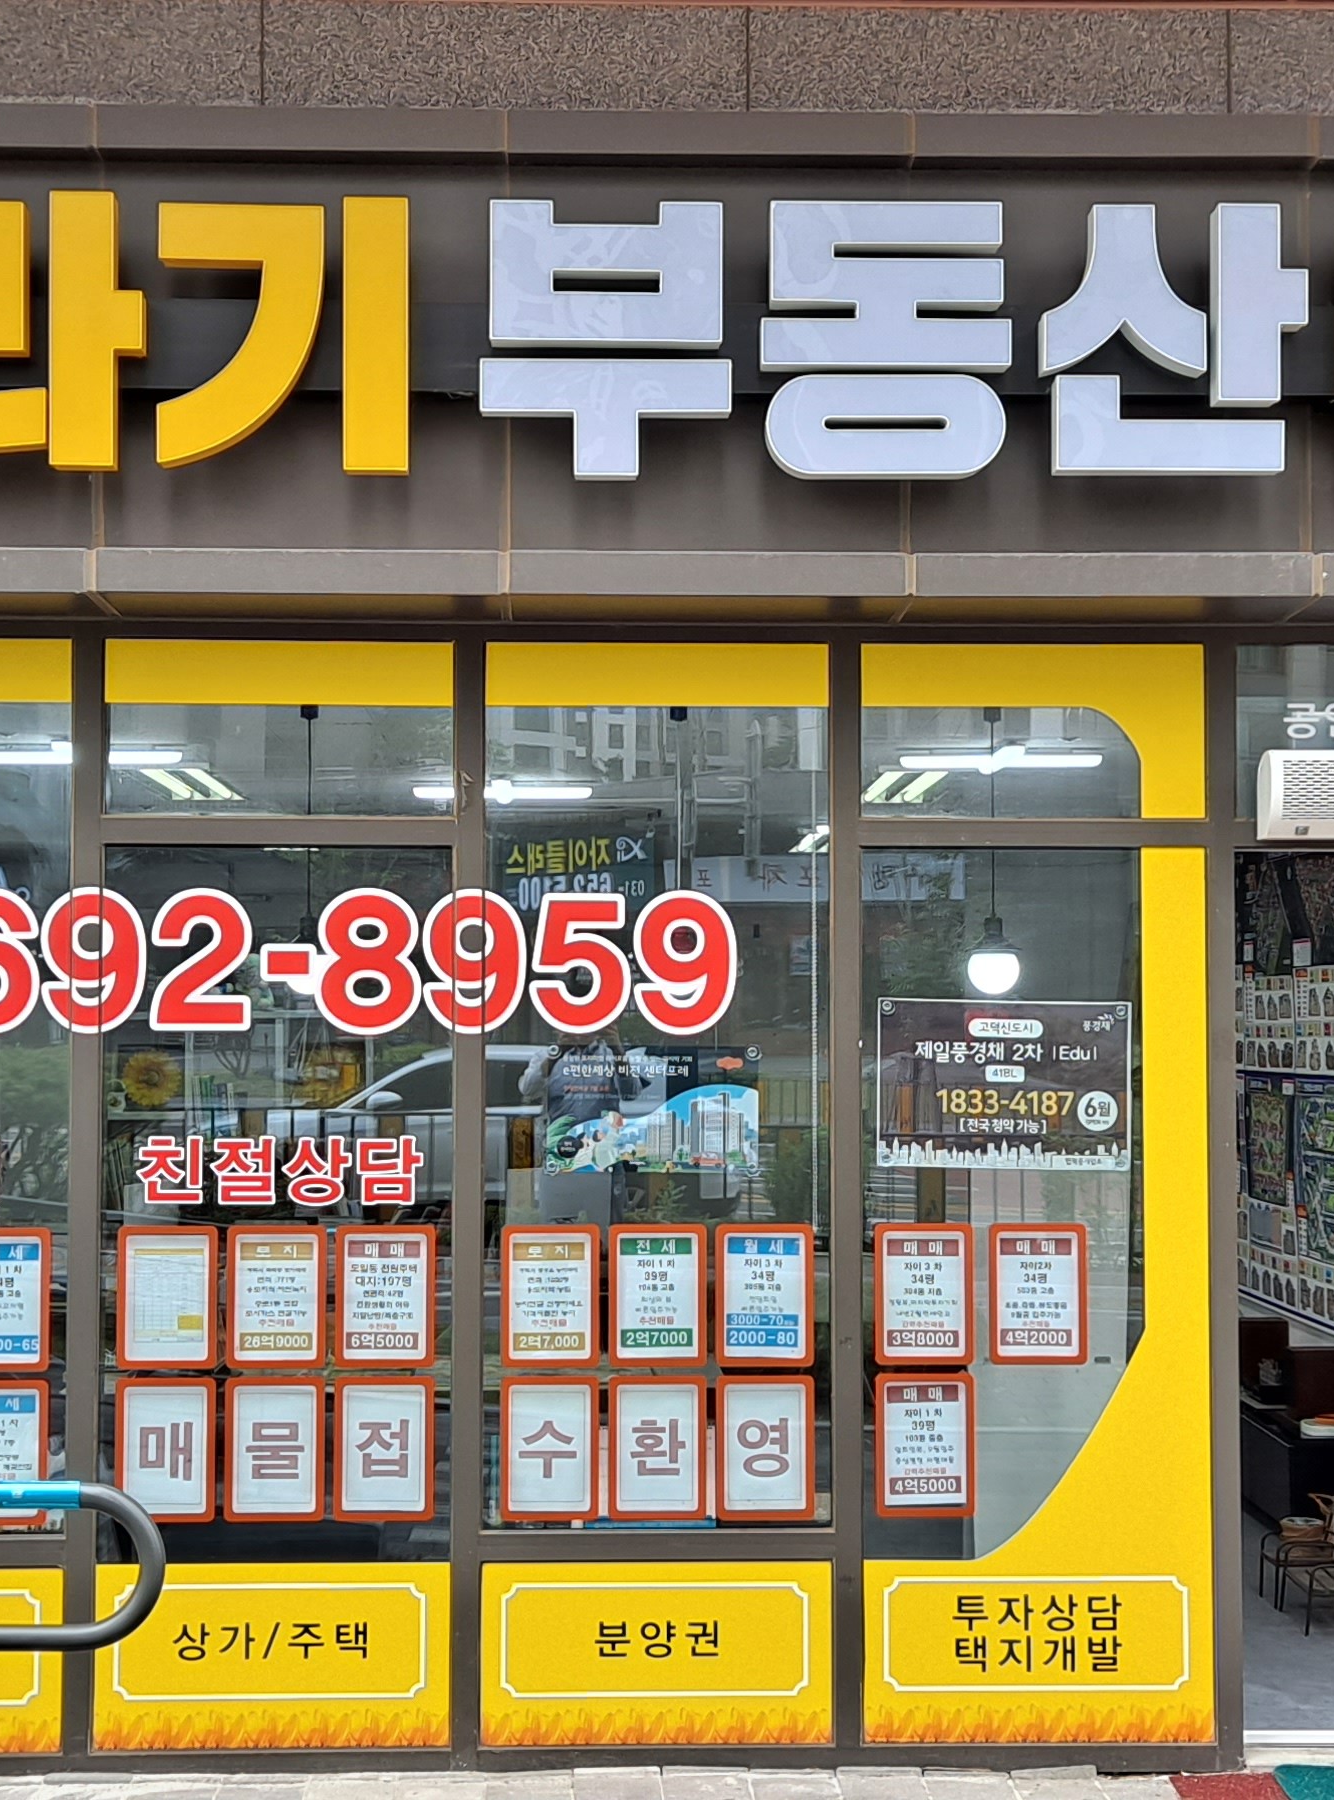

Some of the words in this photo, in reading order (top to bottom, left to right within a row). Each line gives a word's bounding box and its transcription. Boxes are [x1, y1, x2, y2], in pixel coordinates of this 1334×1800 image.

[478, 200, 1309, 482] 부동산
[979, 1022, 1033, 1035] 고덕신도시
[915, 1041, 1004, 1065] 제일풍경채
[1012, 1042, 1044, 1062] 2차
[563, 1064, 615, 1077] e편한세상
[935, 1088, 1075, 1116] 1833-4187
[1084, 1098, 1111, 1117] 6월
[136, 1134, 425, 1206] 친절상담
[1023, 1273, 1048, 1284] 34평
[731, 1315, 784, 1325] 3000-70
[351, 1334, 414, 1348] 6억5000
[519, 1335, 579, 1349] 2억7,000
[626, 1331, 688, 1346] 2억7000
[729, 1331, 795, 1345] 2000-80
[1006, 1330, 1067, 1345] 4억2000
[895, 1478, 957, 1493] 4억5000
[952, 1594, 1122, 1632] 투자상담
[172, 1621, 369, 1662] 상가/주택
[594, 1620, 721, 1658] 분양권
[955, 1635, 1122, 1673] 택지개발
